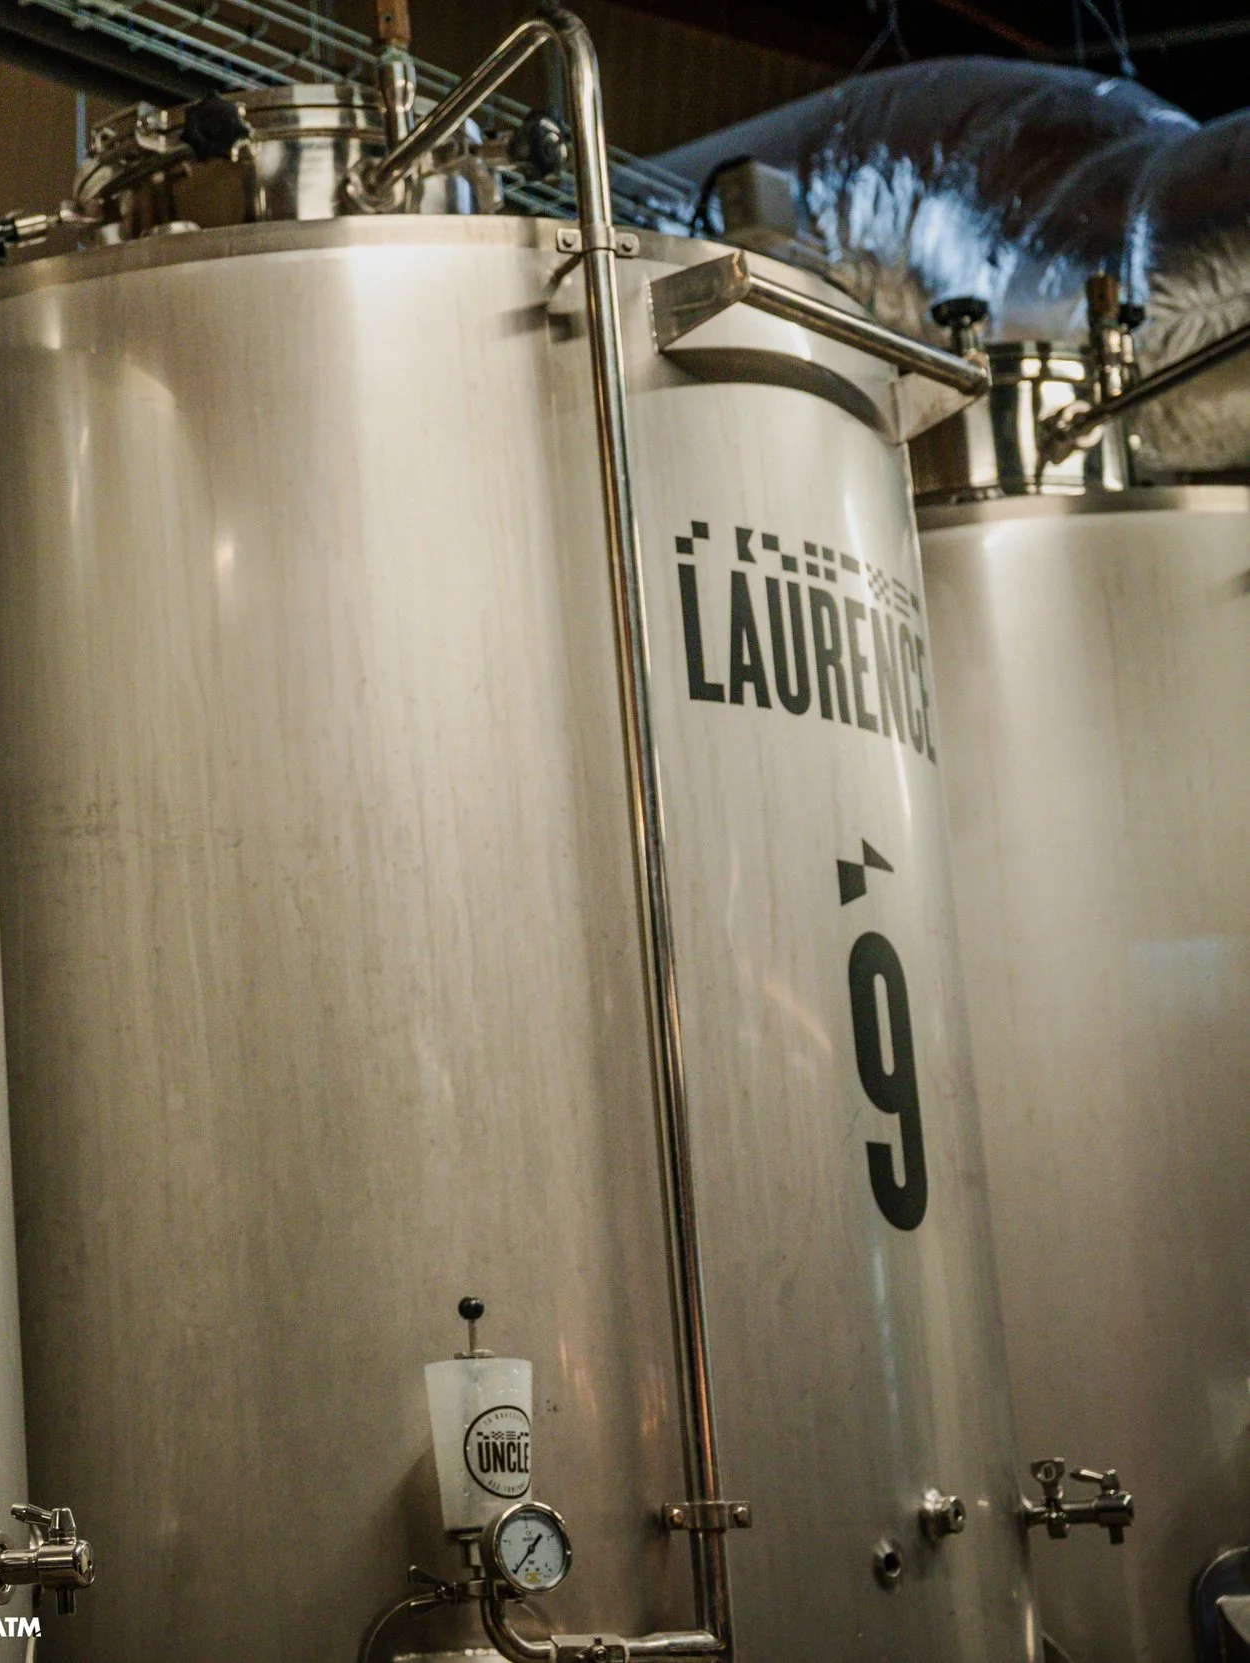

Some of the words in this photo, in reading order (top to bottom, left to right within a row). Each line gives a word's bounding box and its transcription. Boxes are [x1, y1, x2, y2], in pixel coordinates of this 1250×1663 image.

[677, 562, 937, 766] LAURENCE
[848, 930, 928, 1232] 9
[477, 1441, 529, 1474] UNCLE
